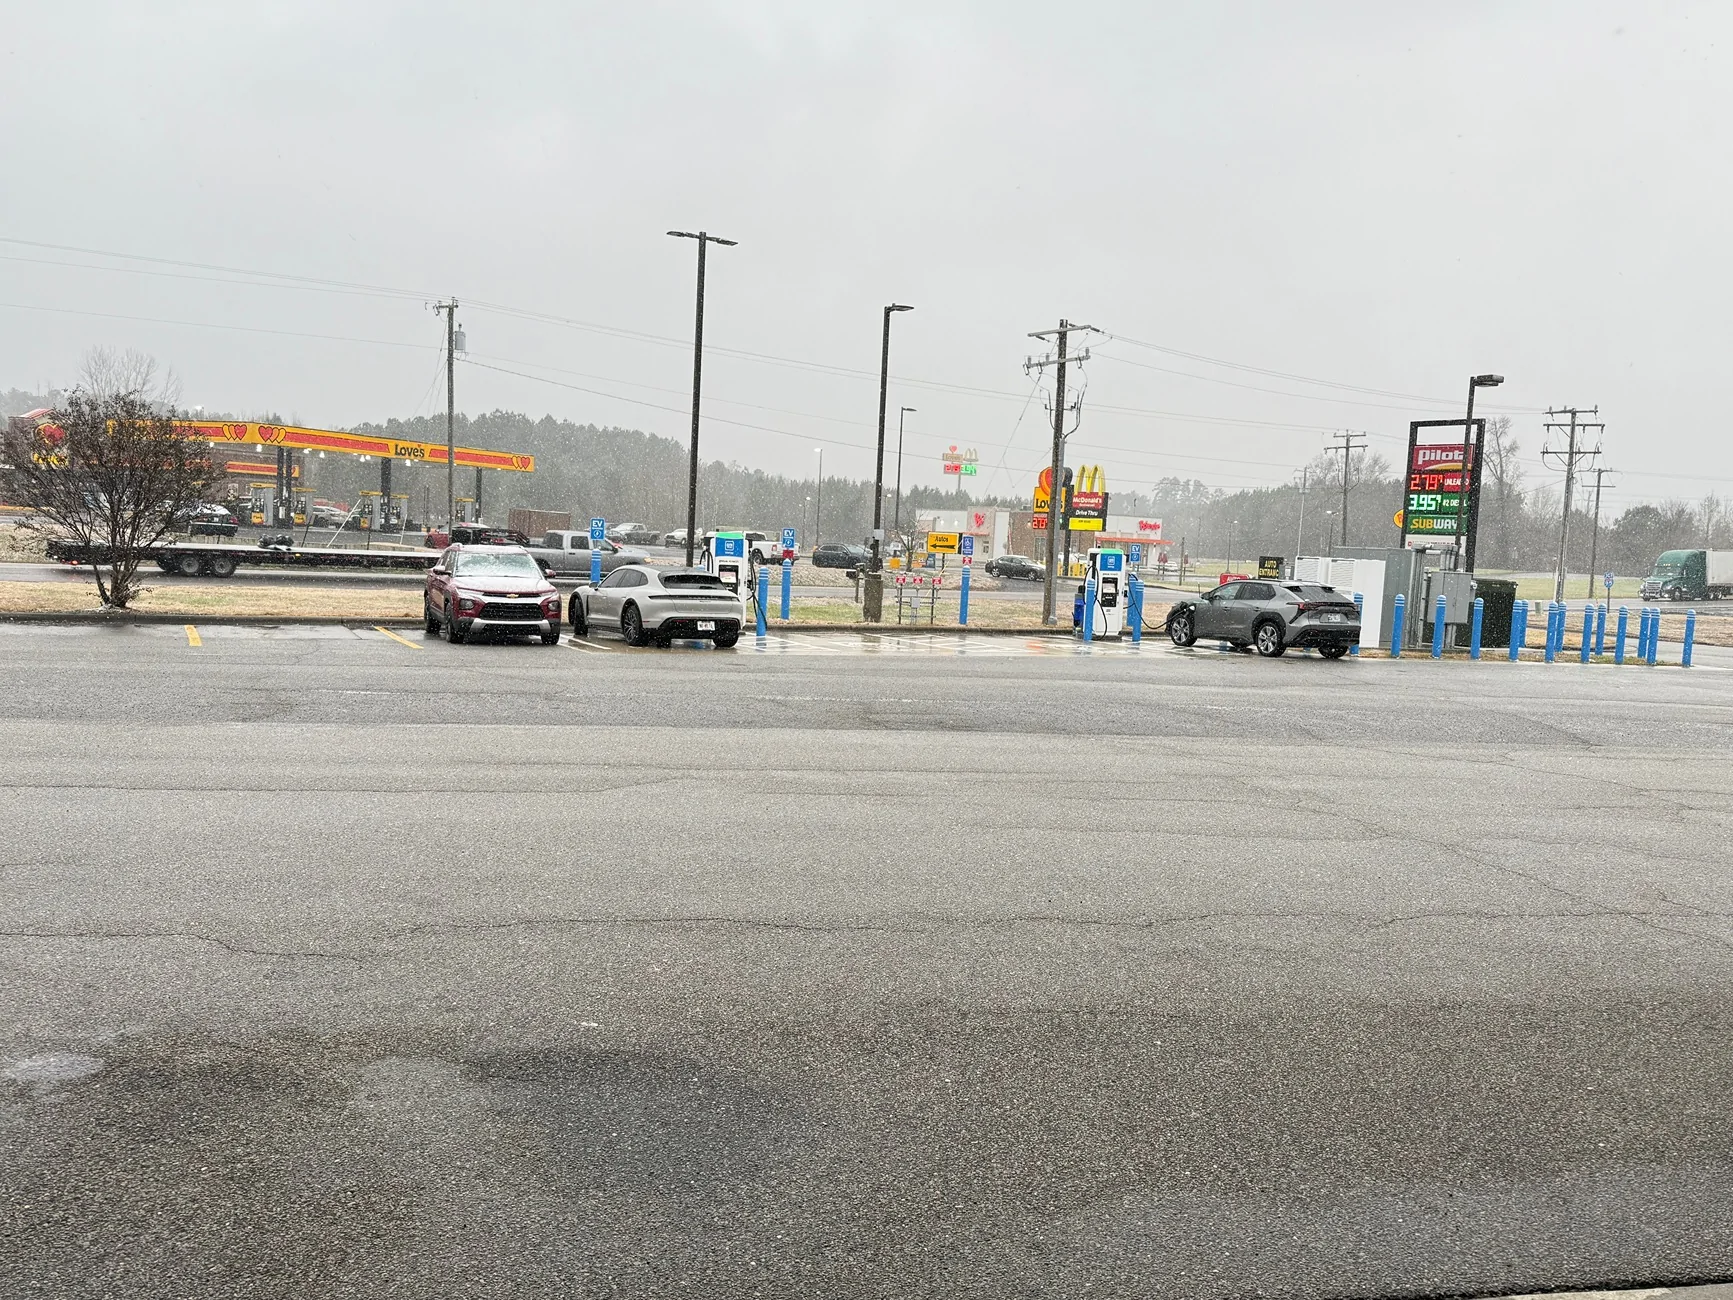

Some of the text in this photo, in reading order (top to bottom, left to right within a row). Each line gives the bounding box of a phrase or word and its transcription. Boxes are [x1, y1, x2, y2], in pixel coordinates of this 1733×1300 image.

[592, 520, 604, 528] EV
[1412, 518, 1458, 530] SUBWAY
[783, 529, 794, 537] EV
